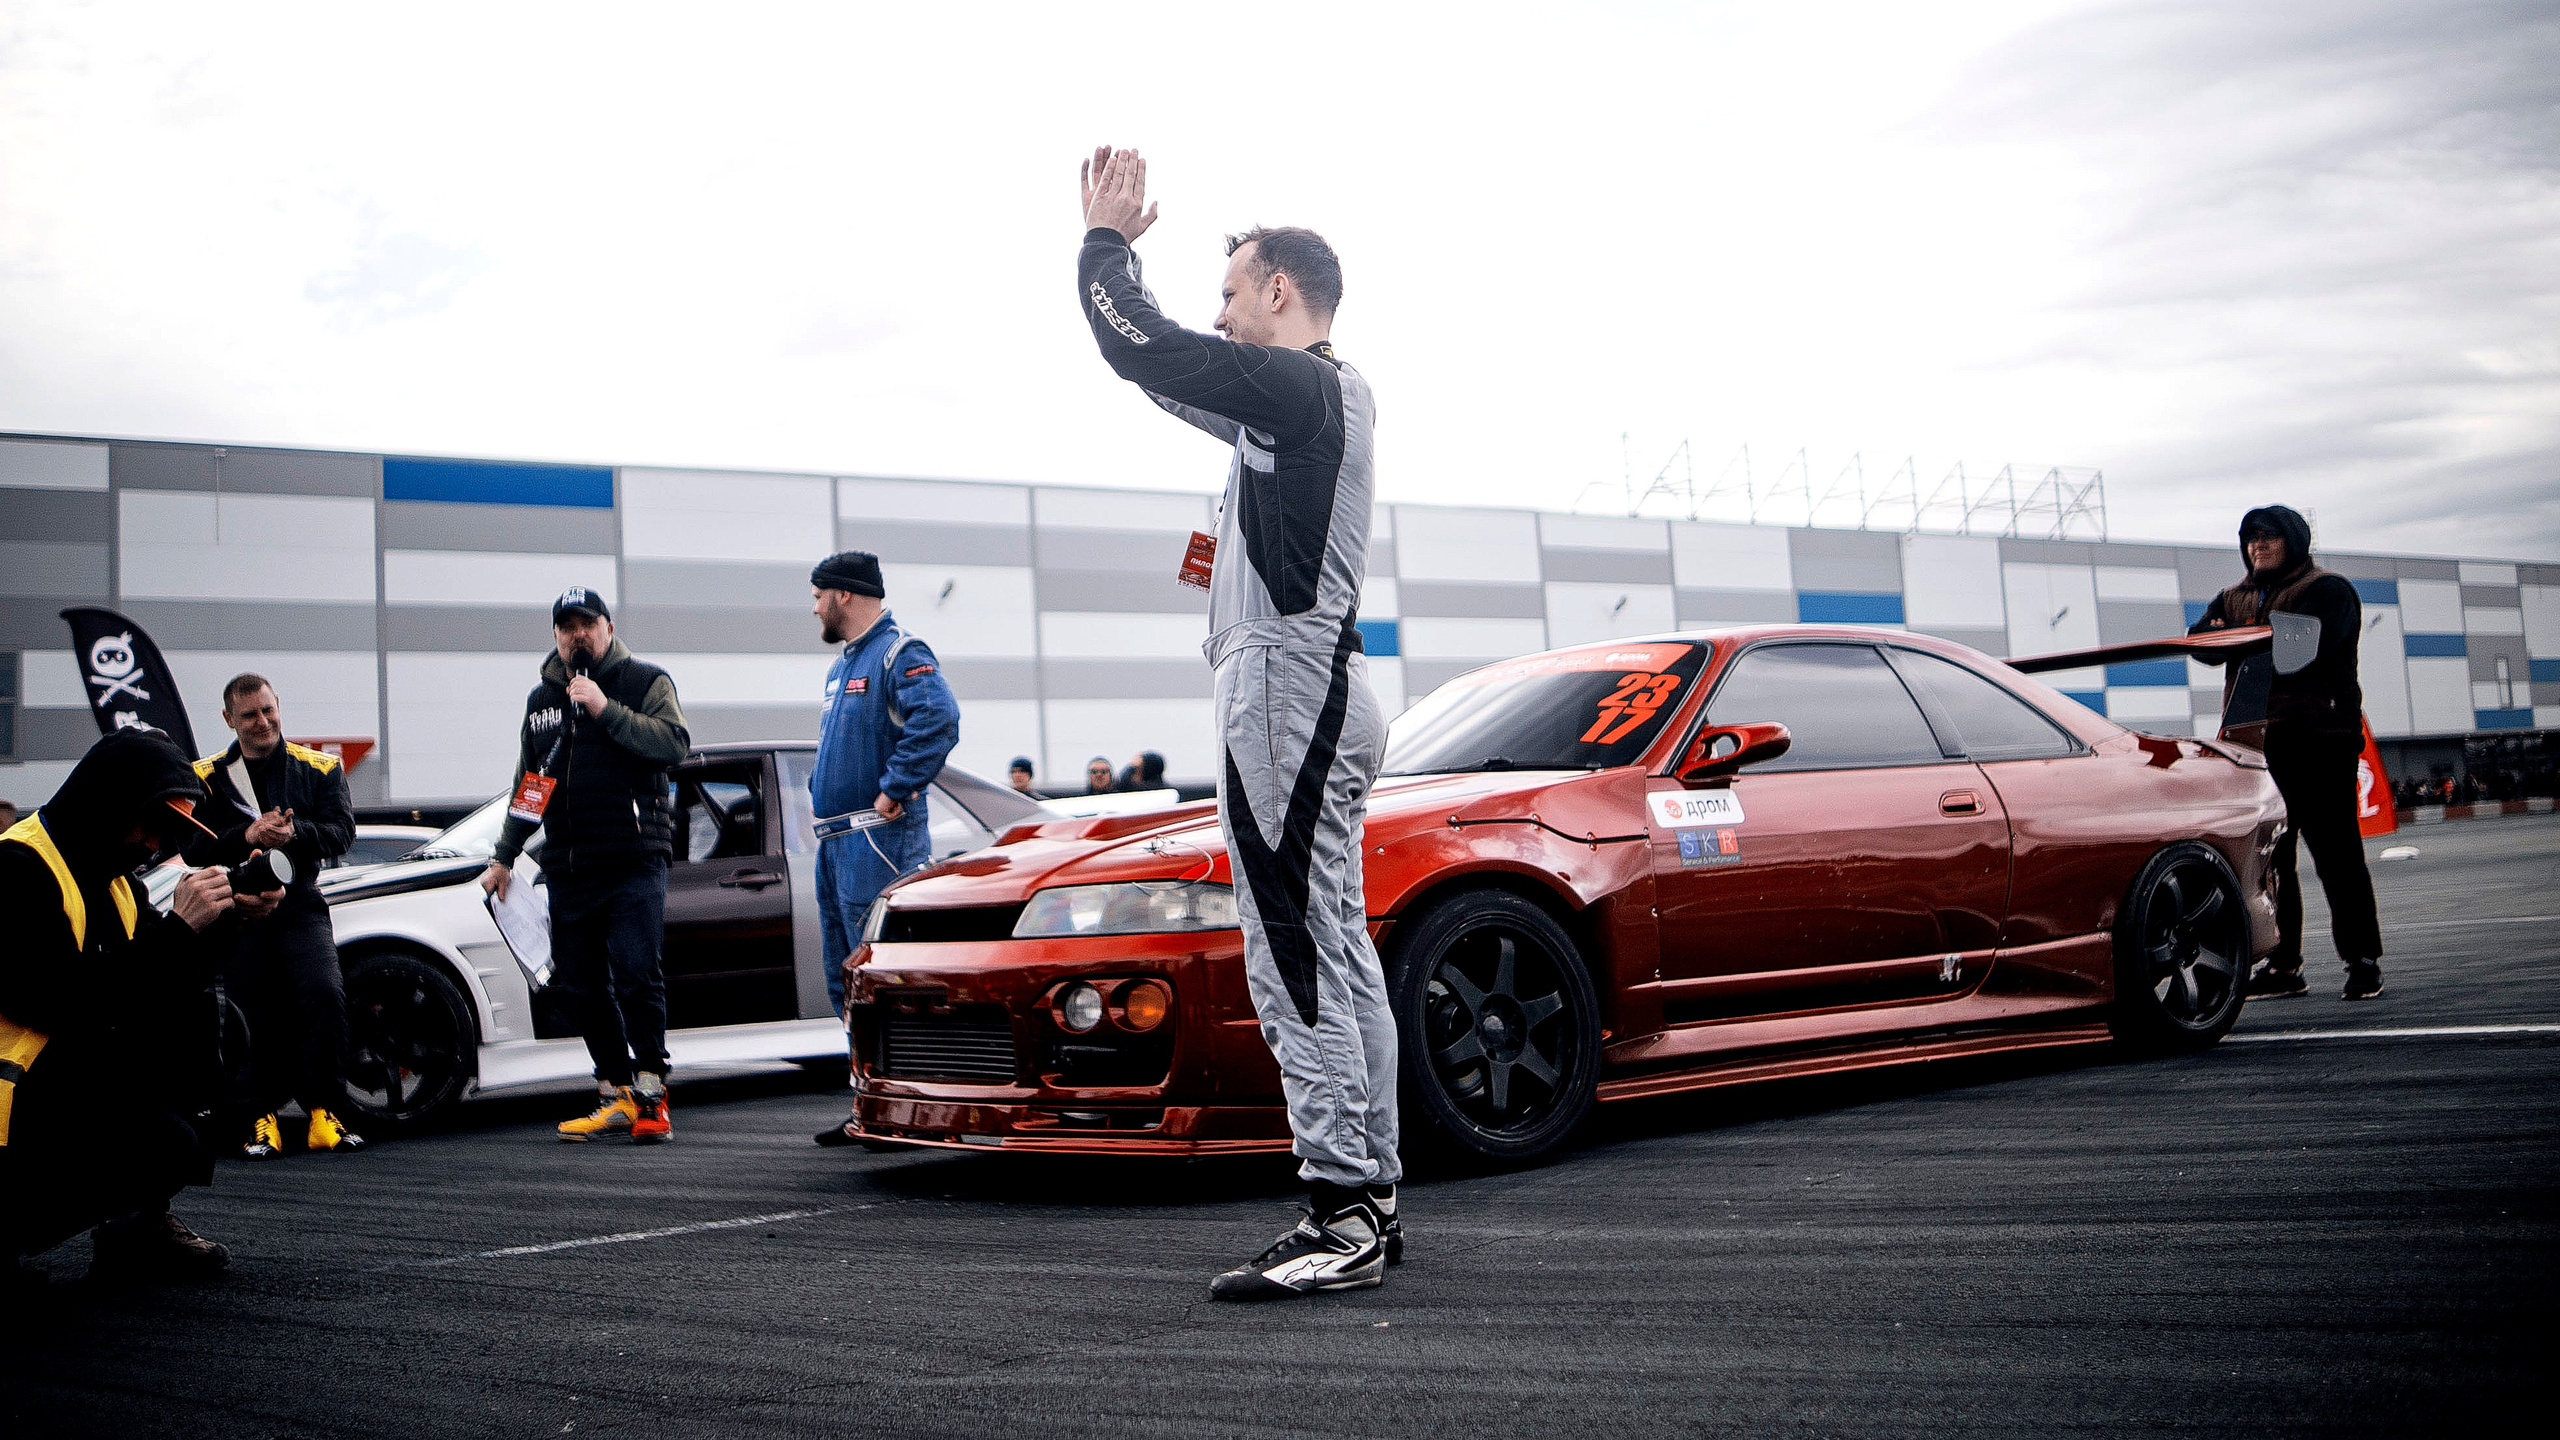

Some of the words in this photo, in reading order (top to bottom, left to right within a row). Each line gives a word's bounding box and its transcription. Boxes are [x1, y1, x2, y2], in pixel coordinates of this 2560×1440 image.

[1597, 672, 1682, 709] 23
[1579, 706, 1657, 745] 17
[1682, 830, 1736, 854] SKR
